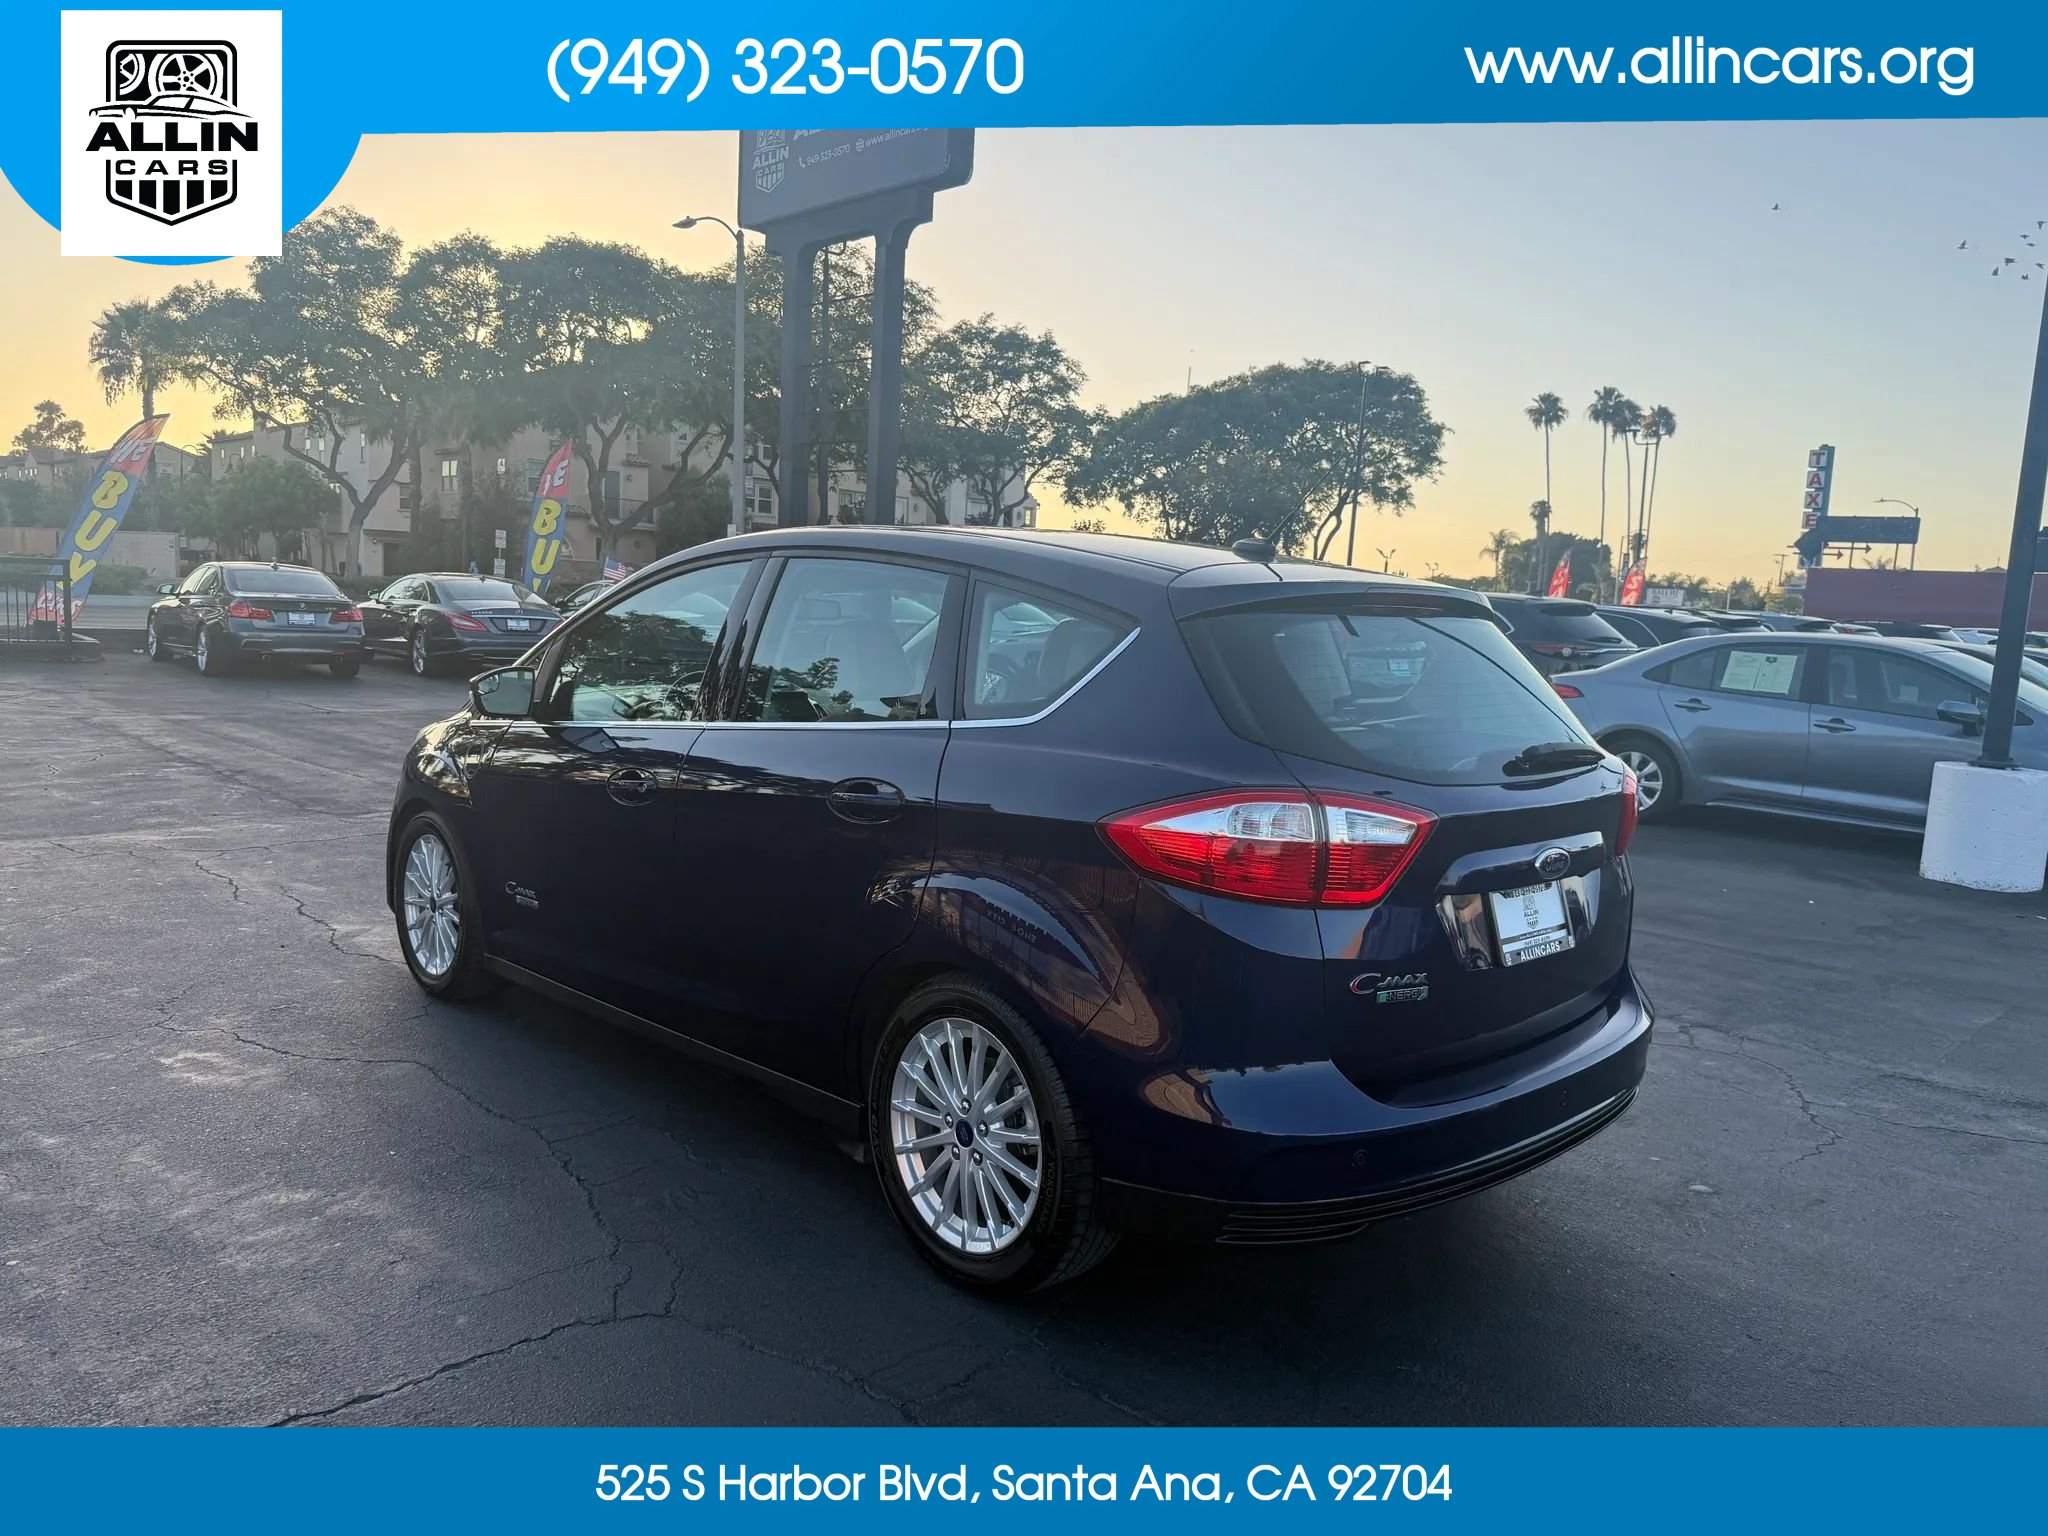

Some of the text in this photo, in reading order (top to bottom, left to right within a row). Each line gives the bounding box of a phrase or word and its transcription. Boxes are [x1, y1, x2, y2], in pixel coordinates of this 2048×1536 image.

[752, 146, 789, 170] ALLIN
[758, 162, 784, 177] CARS
[1804, 451, 1826, 528] TAXE
[1520, 940, 1561, 962] ALLINCARS
